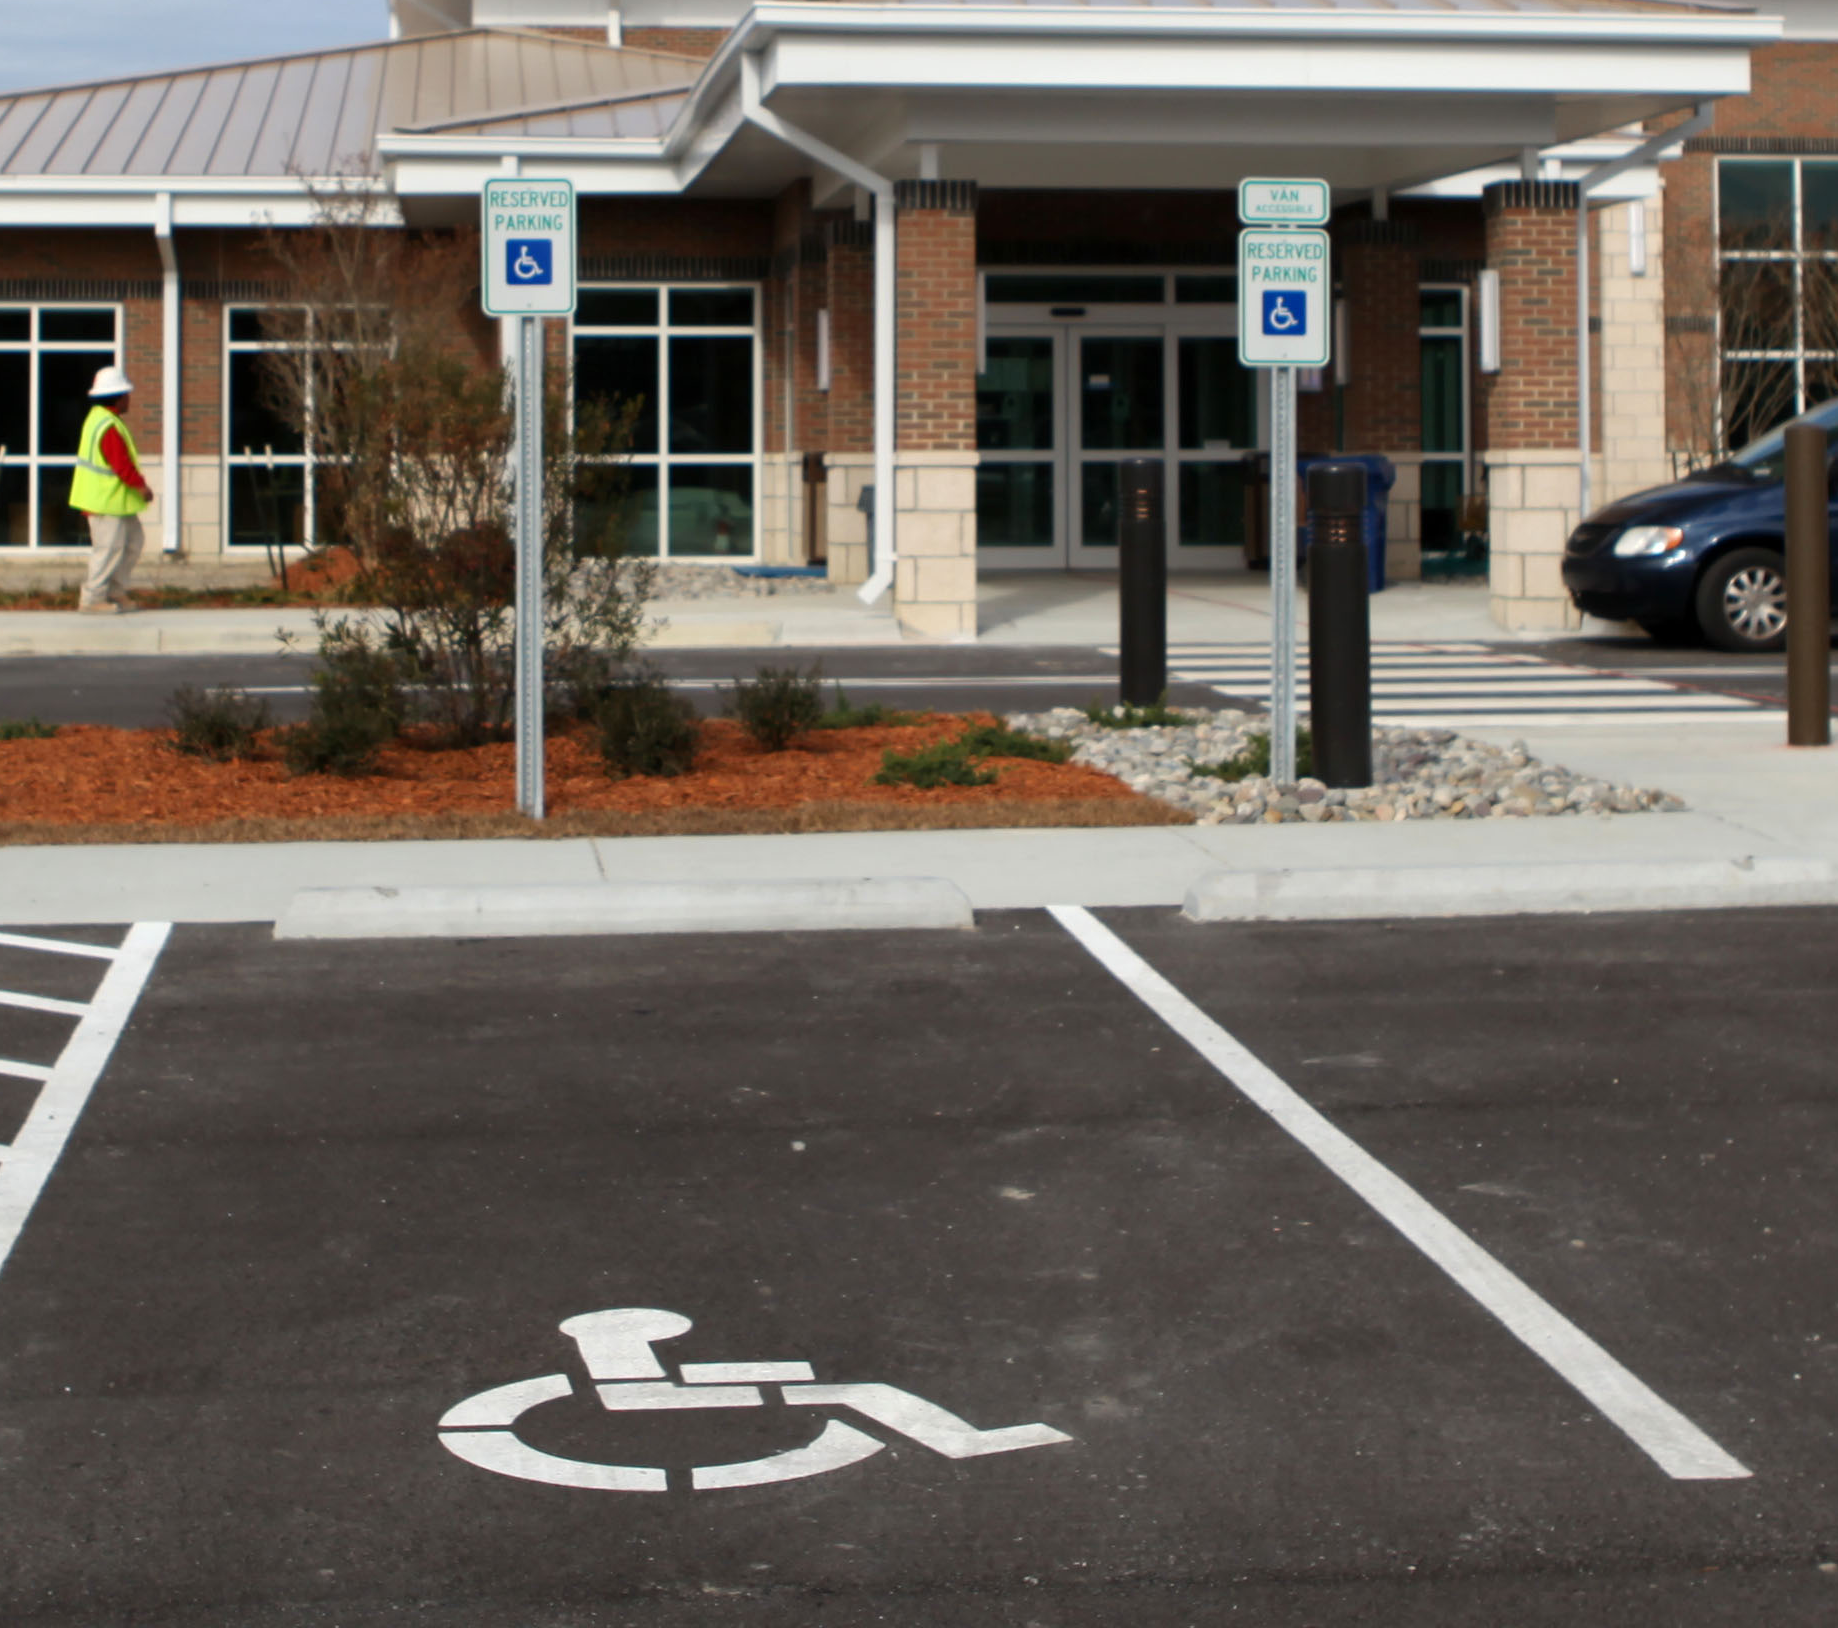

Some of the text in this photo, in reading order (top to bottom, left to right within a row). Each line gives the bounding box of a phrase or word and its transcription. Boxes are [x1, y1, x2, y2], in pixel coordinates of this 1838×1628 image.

[489, 191, 569, 207] RESERVED
[1270, 189, 1299, 202] VAN
[1255, 204, 1314, 214] ACCESSIBLE
[494, 214, 564, 231] PARKING
[1247, 242, 1324, 260] RESERVED
[1251, 265, 1318, 283] PARKING
